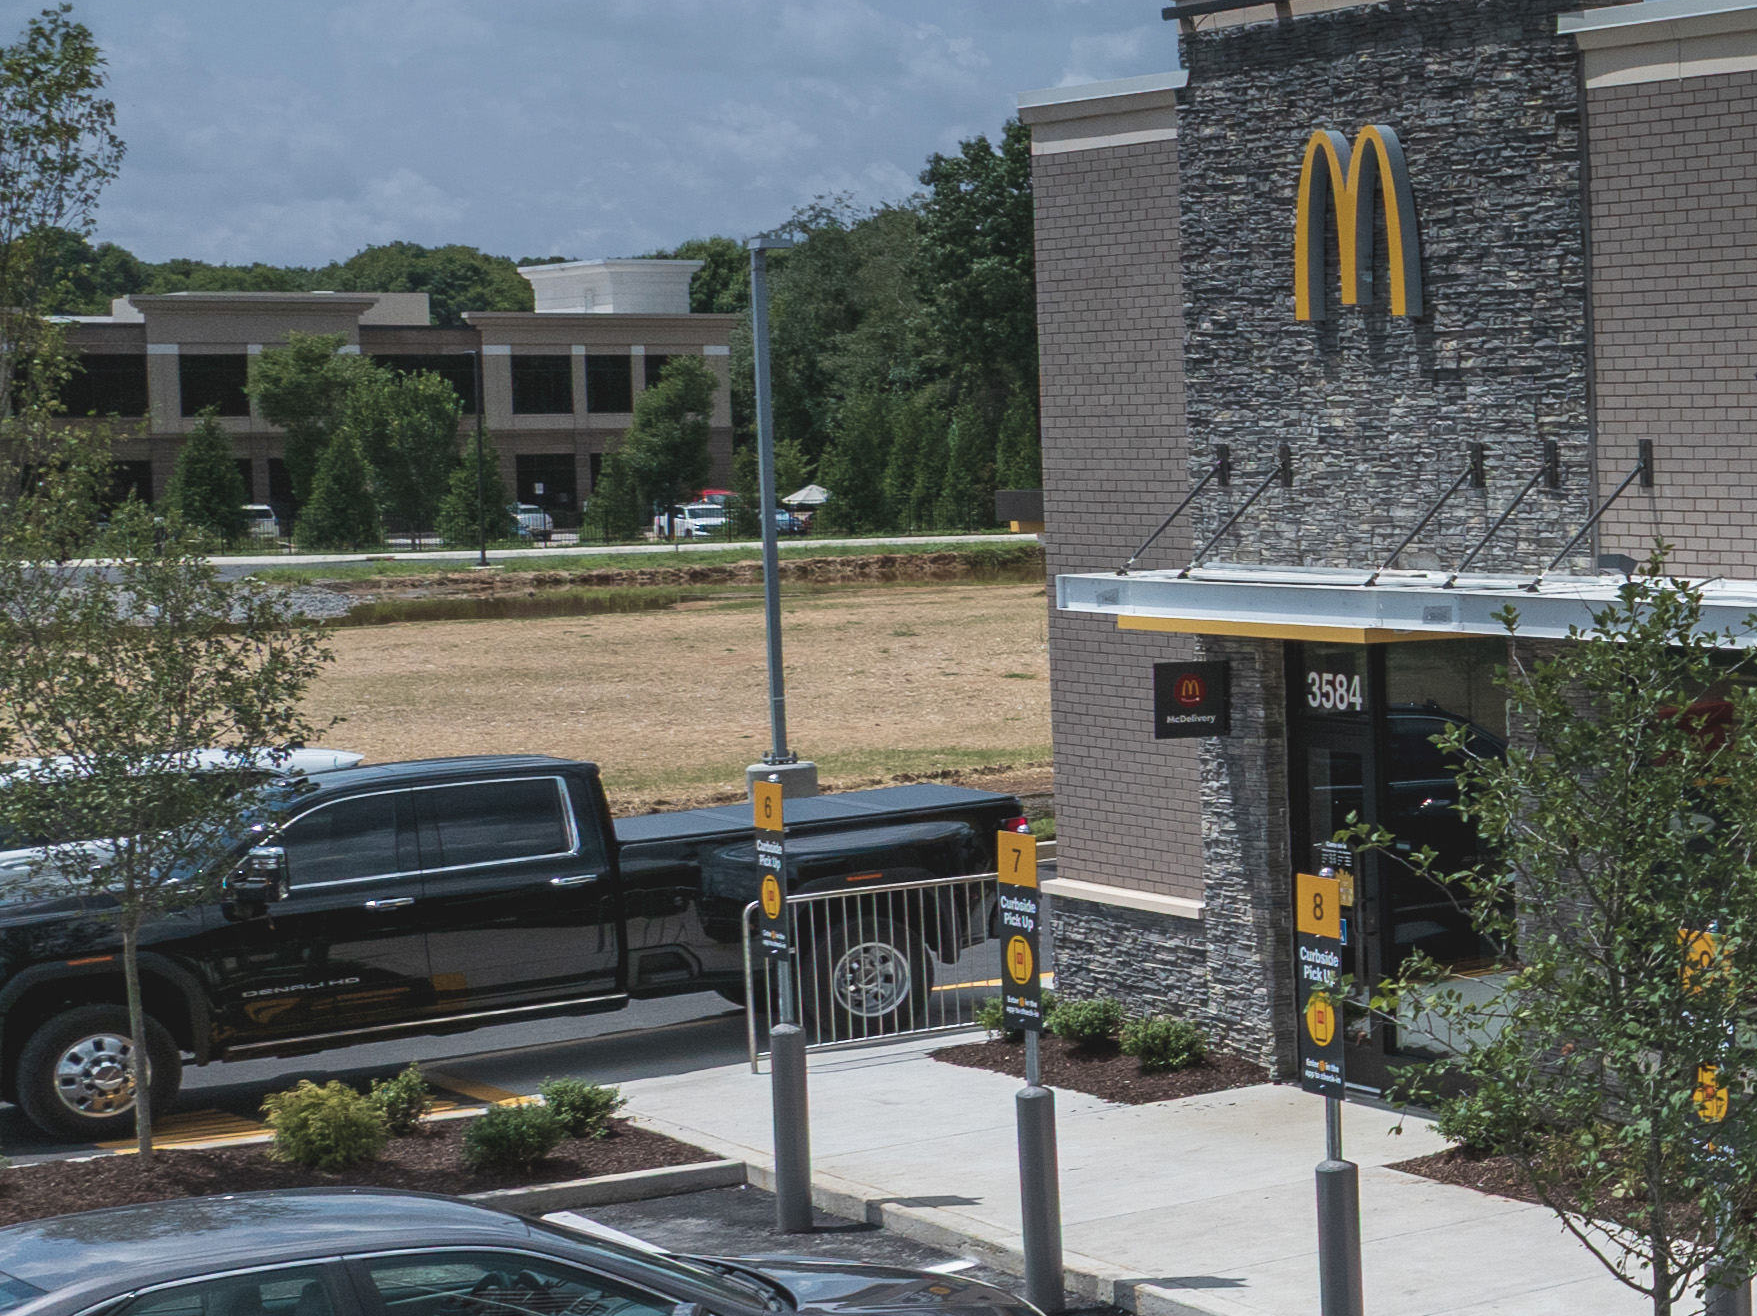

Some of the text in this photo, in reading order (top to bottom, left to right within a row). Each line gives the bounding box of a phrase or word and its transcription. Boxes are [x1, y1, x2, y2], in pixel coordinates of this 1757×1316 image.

[1307, 671, 1363, 712] 3584
[1166, 714, 1216, 724] McDelivery
[764, 796, 772, 819] 6
[1012, 848, 1022, 873] 7
[1000, 895, 1037, 914] Curbside
[1313, 892, 1324, 920] 8
[1003, 912, 1034, 933] Pick Up
[1300, 945, 1339, 967] Curbside
[1303, 964, 1323, 982] Pick
[242, 977, 360, 998] DENALI HD
